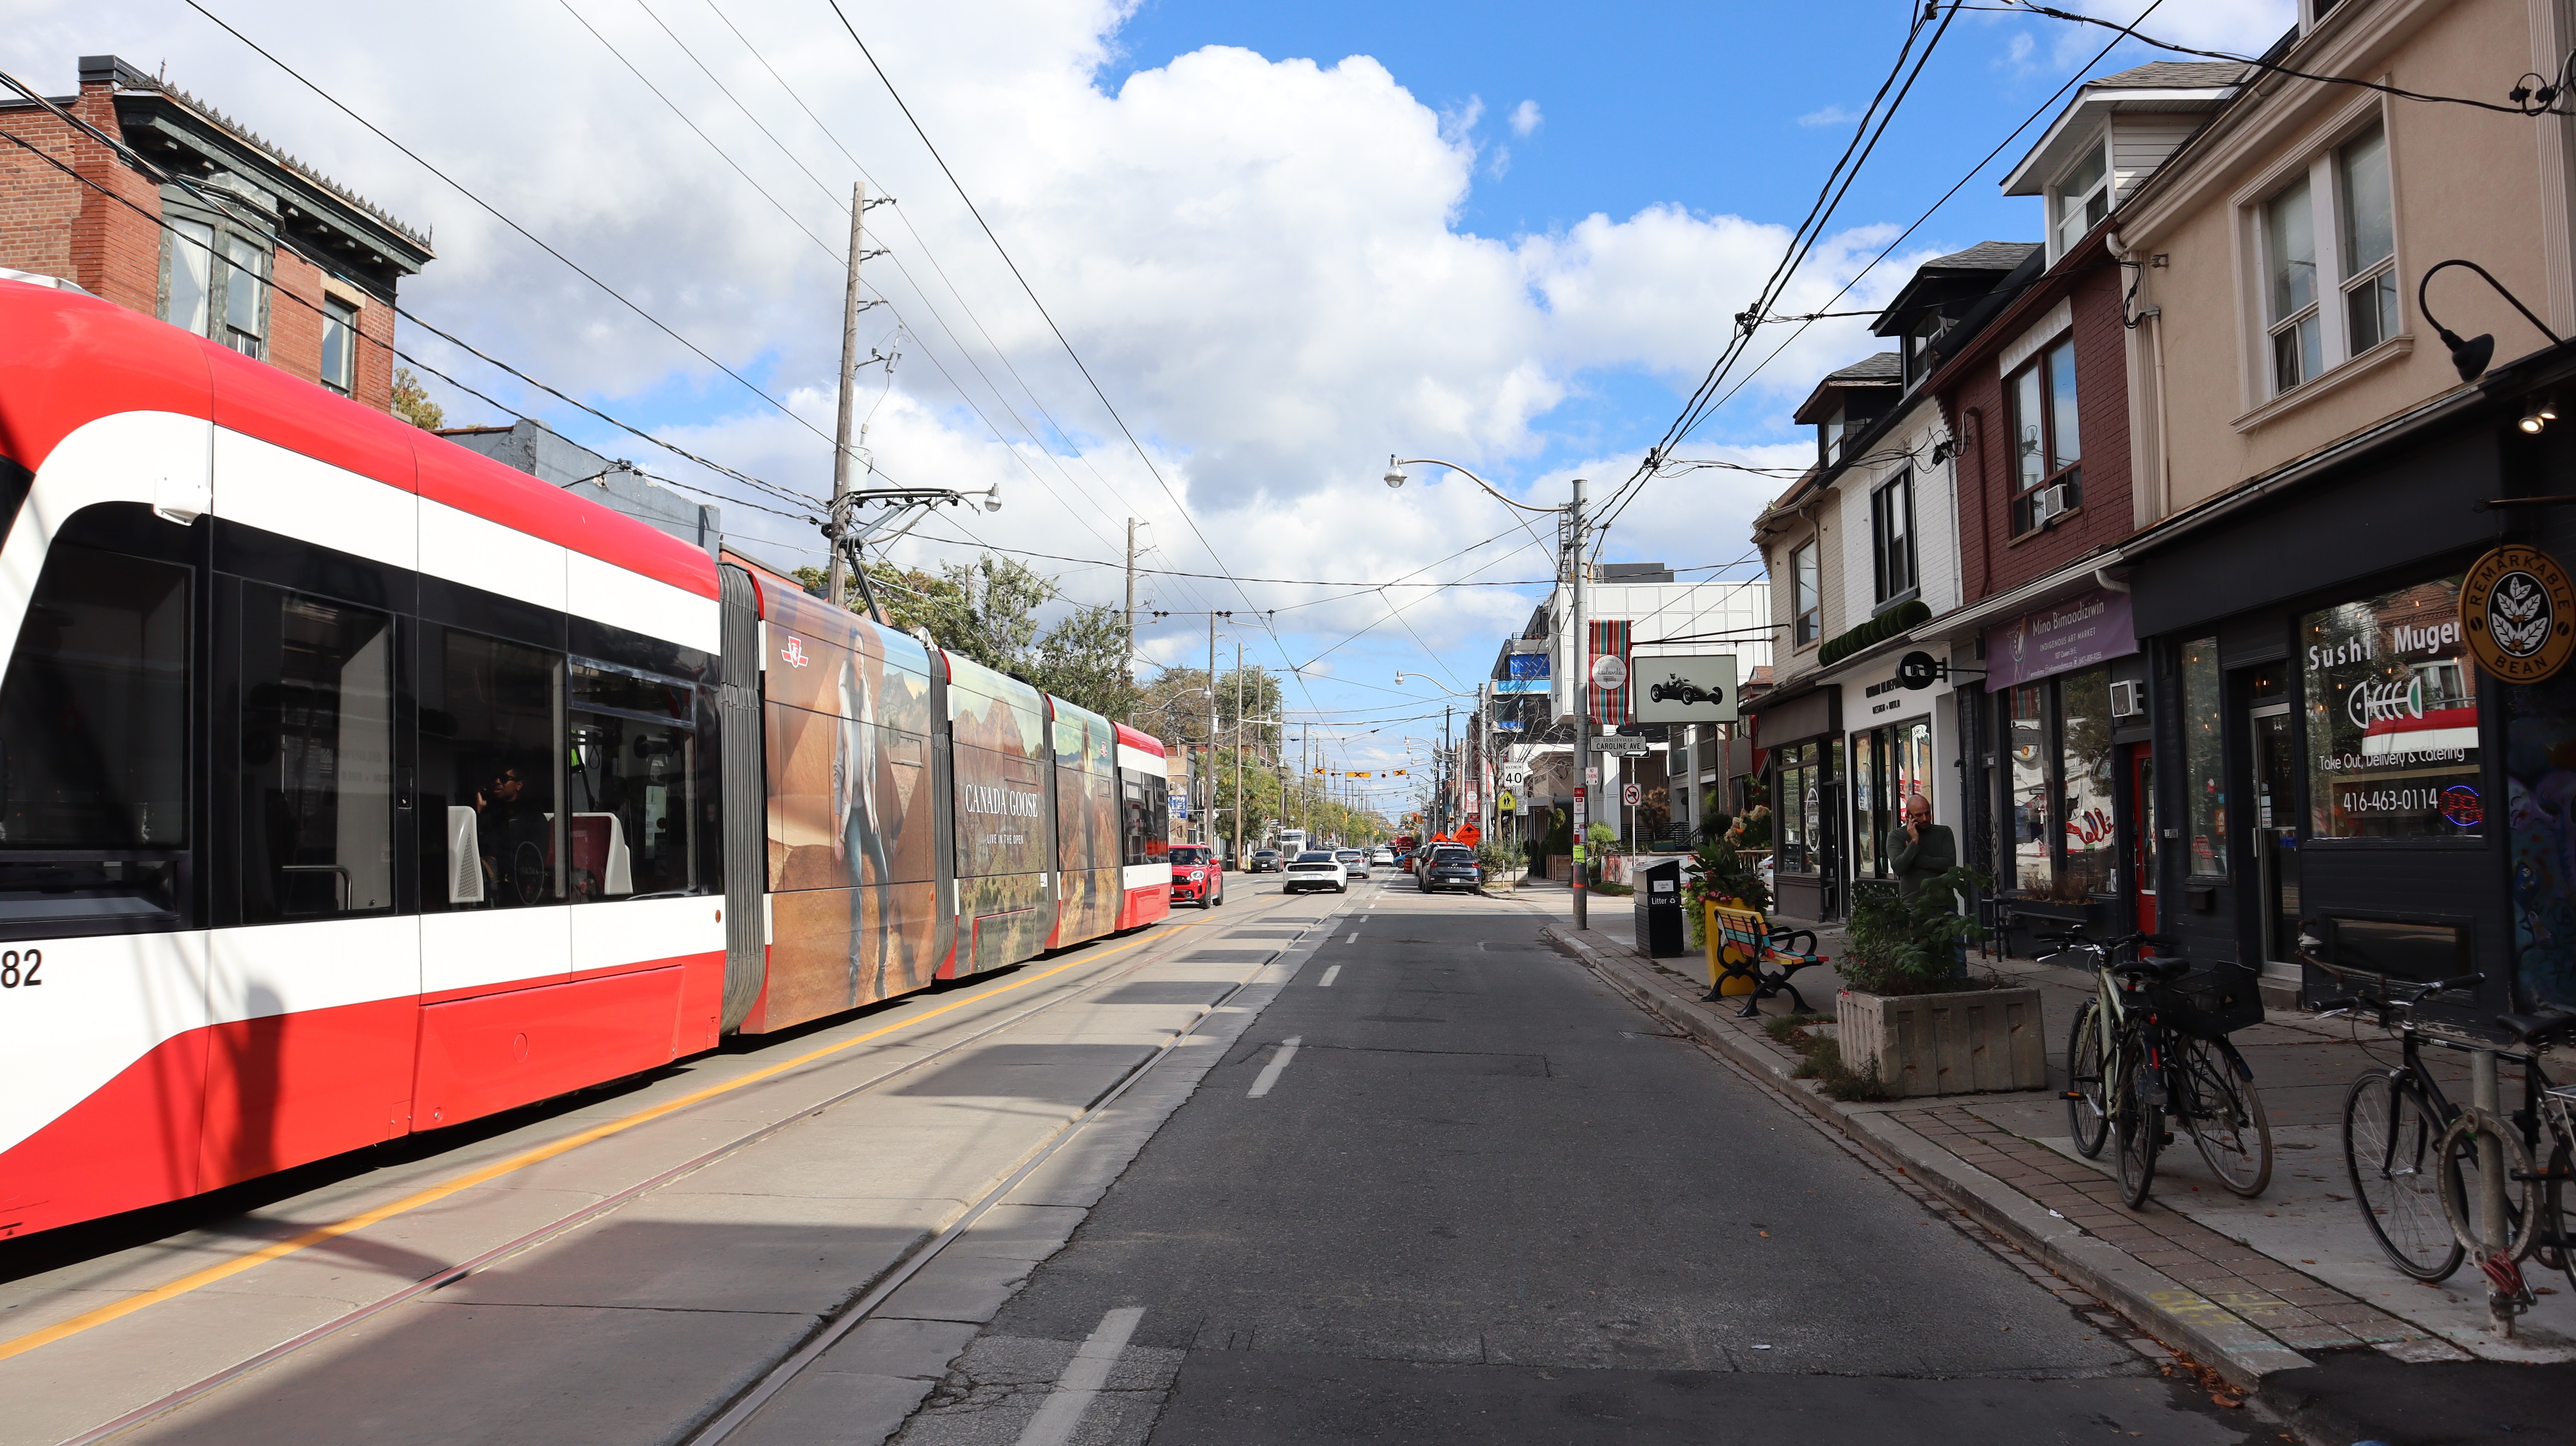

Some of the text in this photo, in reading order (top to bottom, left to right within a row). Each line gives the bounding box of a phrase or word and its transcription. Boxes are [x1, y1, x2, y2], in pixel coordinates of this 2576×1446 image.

[2470, 555, 2571, 610] REMARKABLE
[2033, 599, 2104, 636] Mino Bimaadiziwin
[2040, 627, 2096, 652] INDIGENOUS ART MARKET
[2309, 634, 2371, 671] Sushi
[2494, 655, 2548, 674] BEAN
[1594, 666, 1625, 675] Leslieville
[2319, 755, 2342, 770] Take
[2344, 753, 2364, 769] Out,
[2366, 751, 2405, 768] Delivery
[2419, 745, 2465, 762] Catering
[1506, 772, 1522, 784] 40
[965, 784, 1038, 817] CANADA GOOSE
[2343, 788, 2439, 812] 416-463-0114
[987, 834, 1024, 845] LIVE IN THE OPEN
[0, 949, 43, 989] 82
